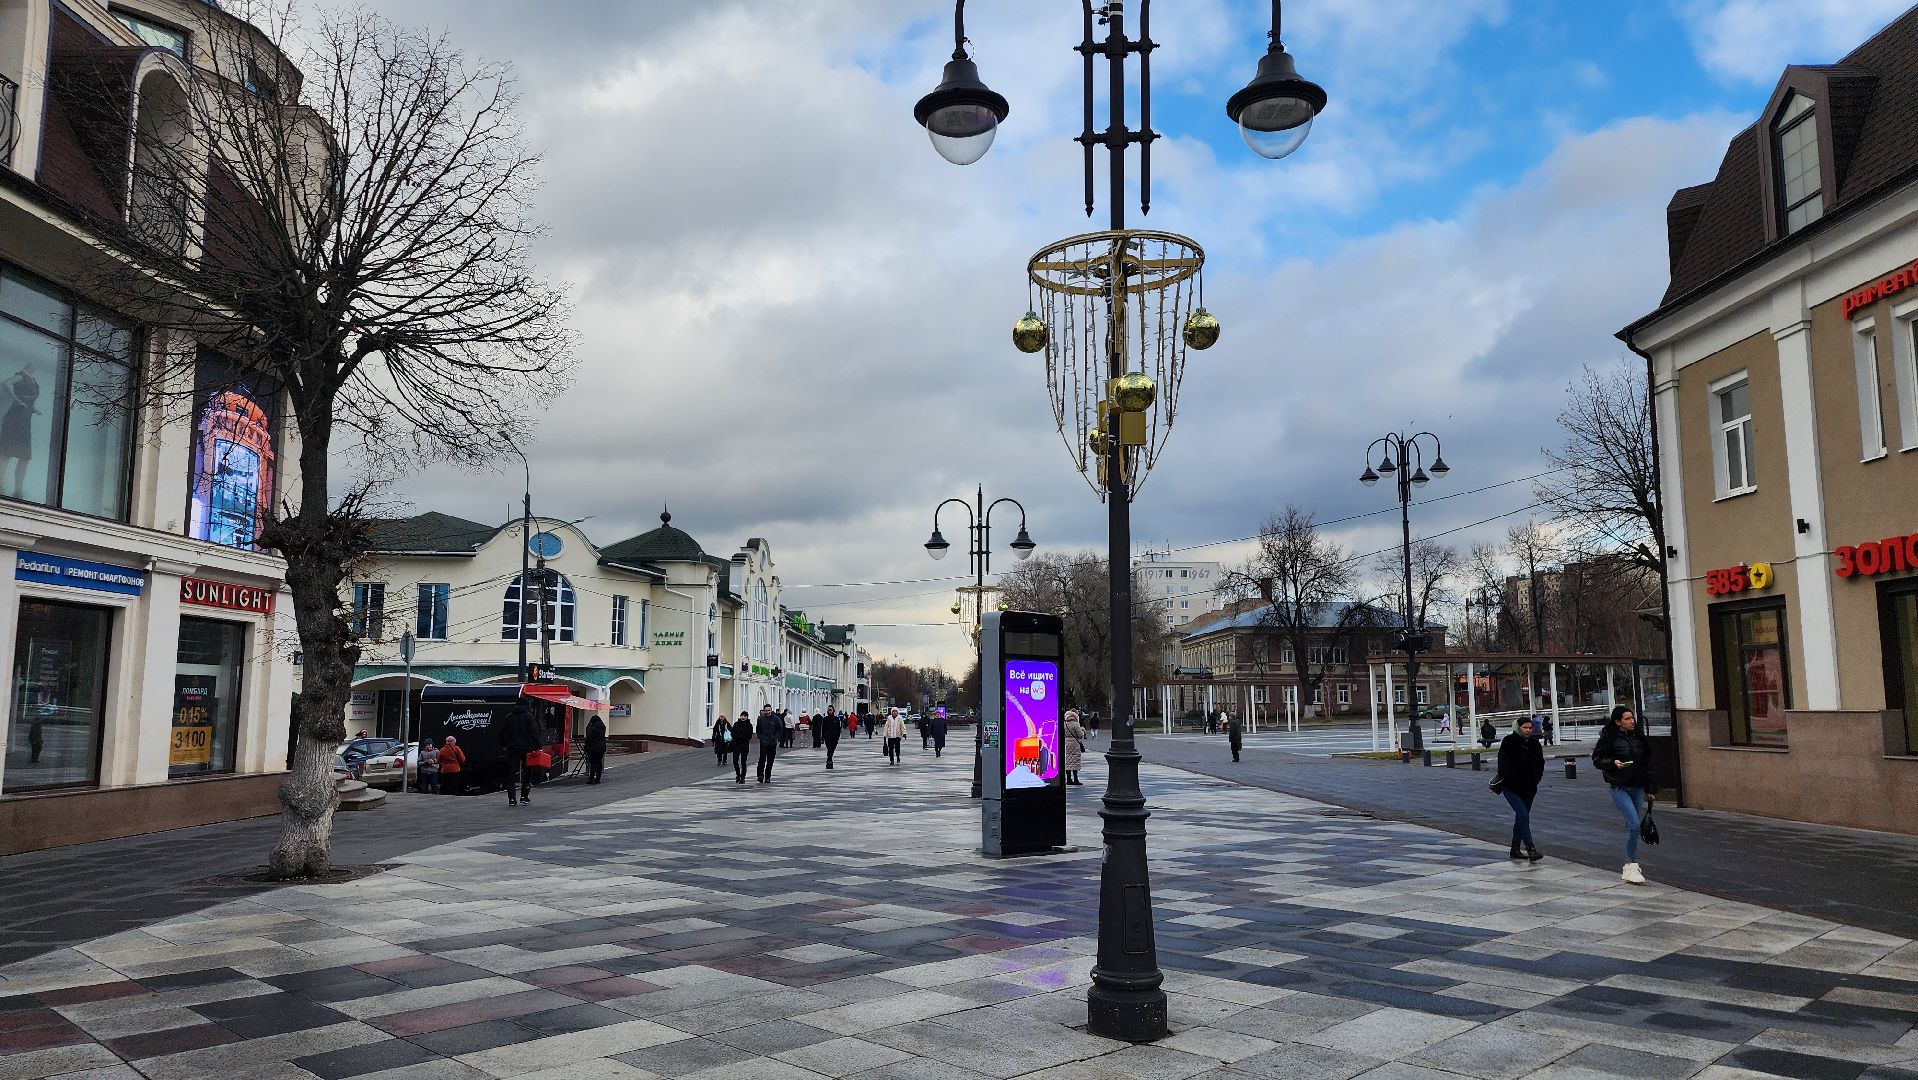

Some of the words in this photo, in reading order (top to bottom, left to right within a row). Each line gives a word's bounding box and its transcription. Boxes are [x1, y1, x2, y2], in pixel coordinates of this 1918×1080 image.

[68, 567, 98, 580] РЕМОНТ
[99, 572, 145, 587] СМАРТФОНОВ
[1145, 570, 1163, 580] 1917
[1188, 568, 1210, 579] 1967
[1706, 566, 1745, 595] 585
[184, 580, 271, 609] SUNLIGHT
[1009, 669, 1026, 680] Всё
[1028, 672, 1054, 681] ищите
[182, 687, 208, 696] ЛОМБАРД
[1019, 686, 1030, 695] на
